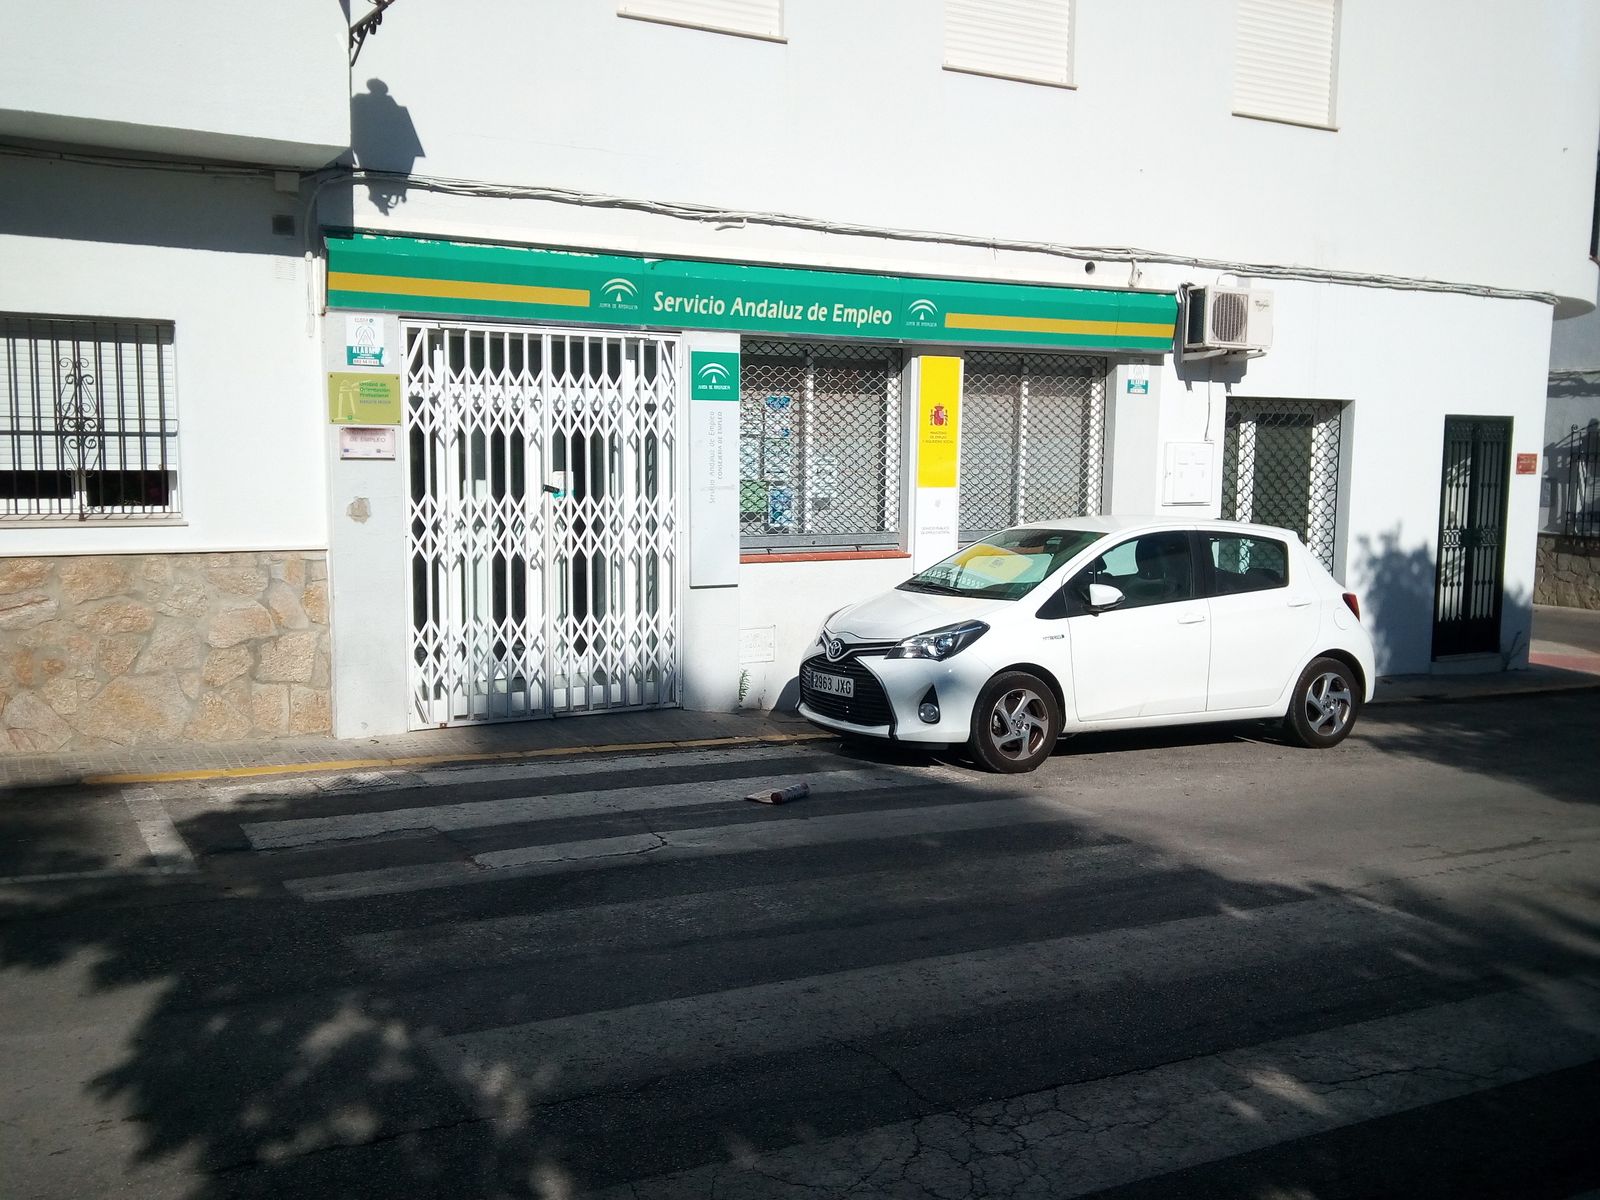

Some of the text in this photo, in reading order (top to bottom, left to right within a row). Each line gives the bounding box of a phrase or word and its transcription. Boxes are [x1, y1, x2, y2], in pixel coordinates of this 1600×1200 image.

[653, 291, 893, 329] Servicio Andaluz de Empleo
[708, 411, 717, 436] Empleo
[708, 449, 716, 477] Andaluz
[814, 674, 851, 694] 2963 JXG
